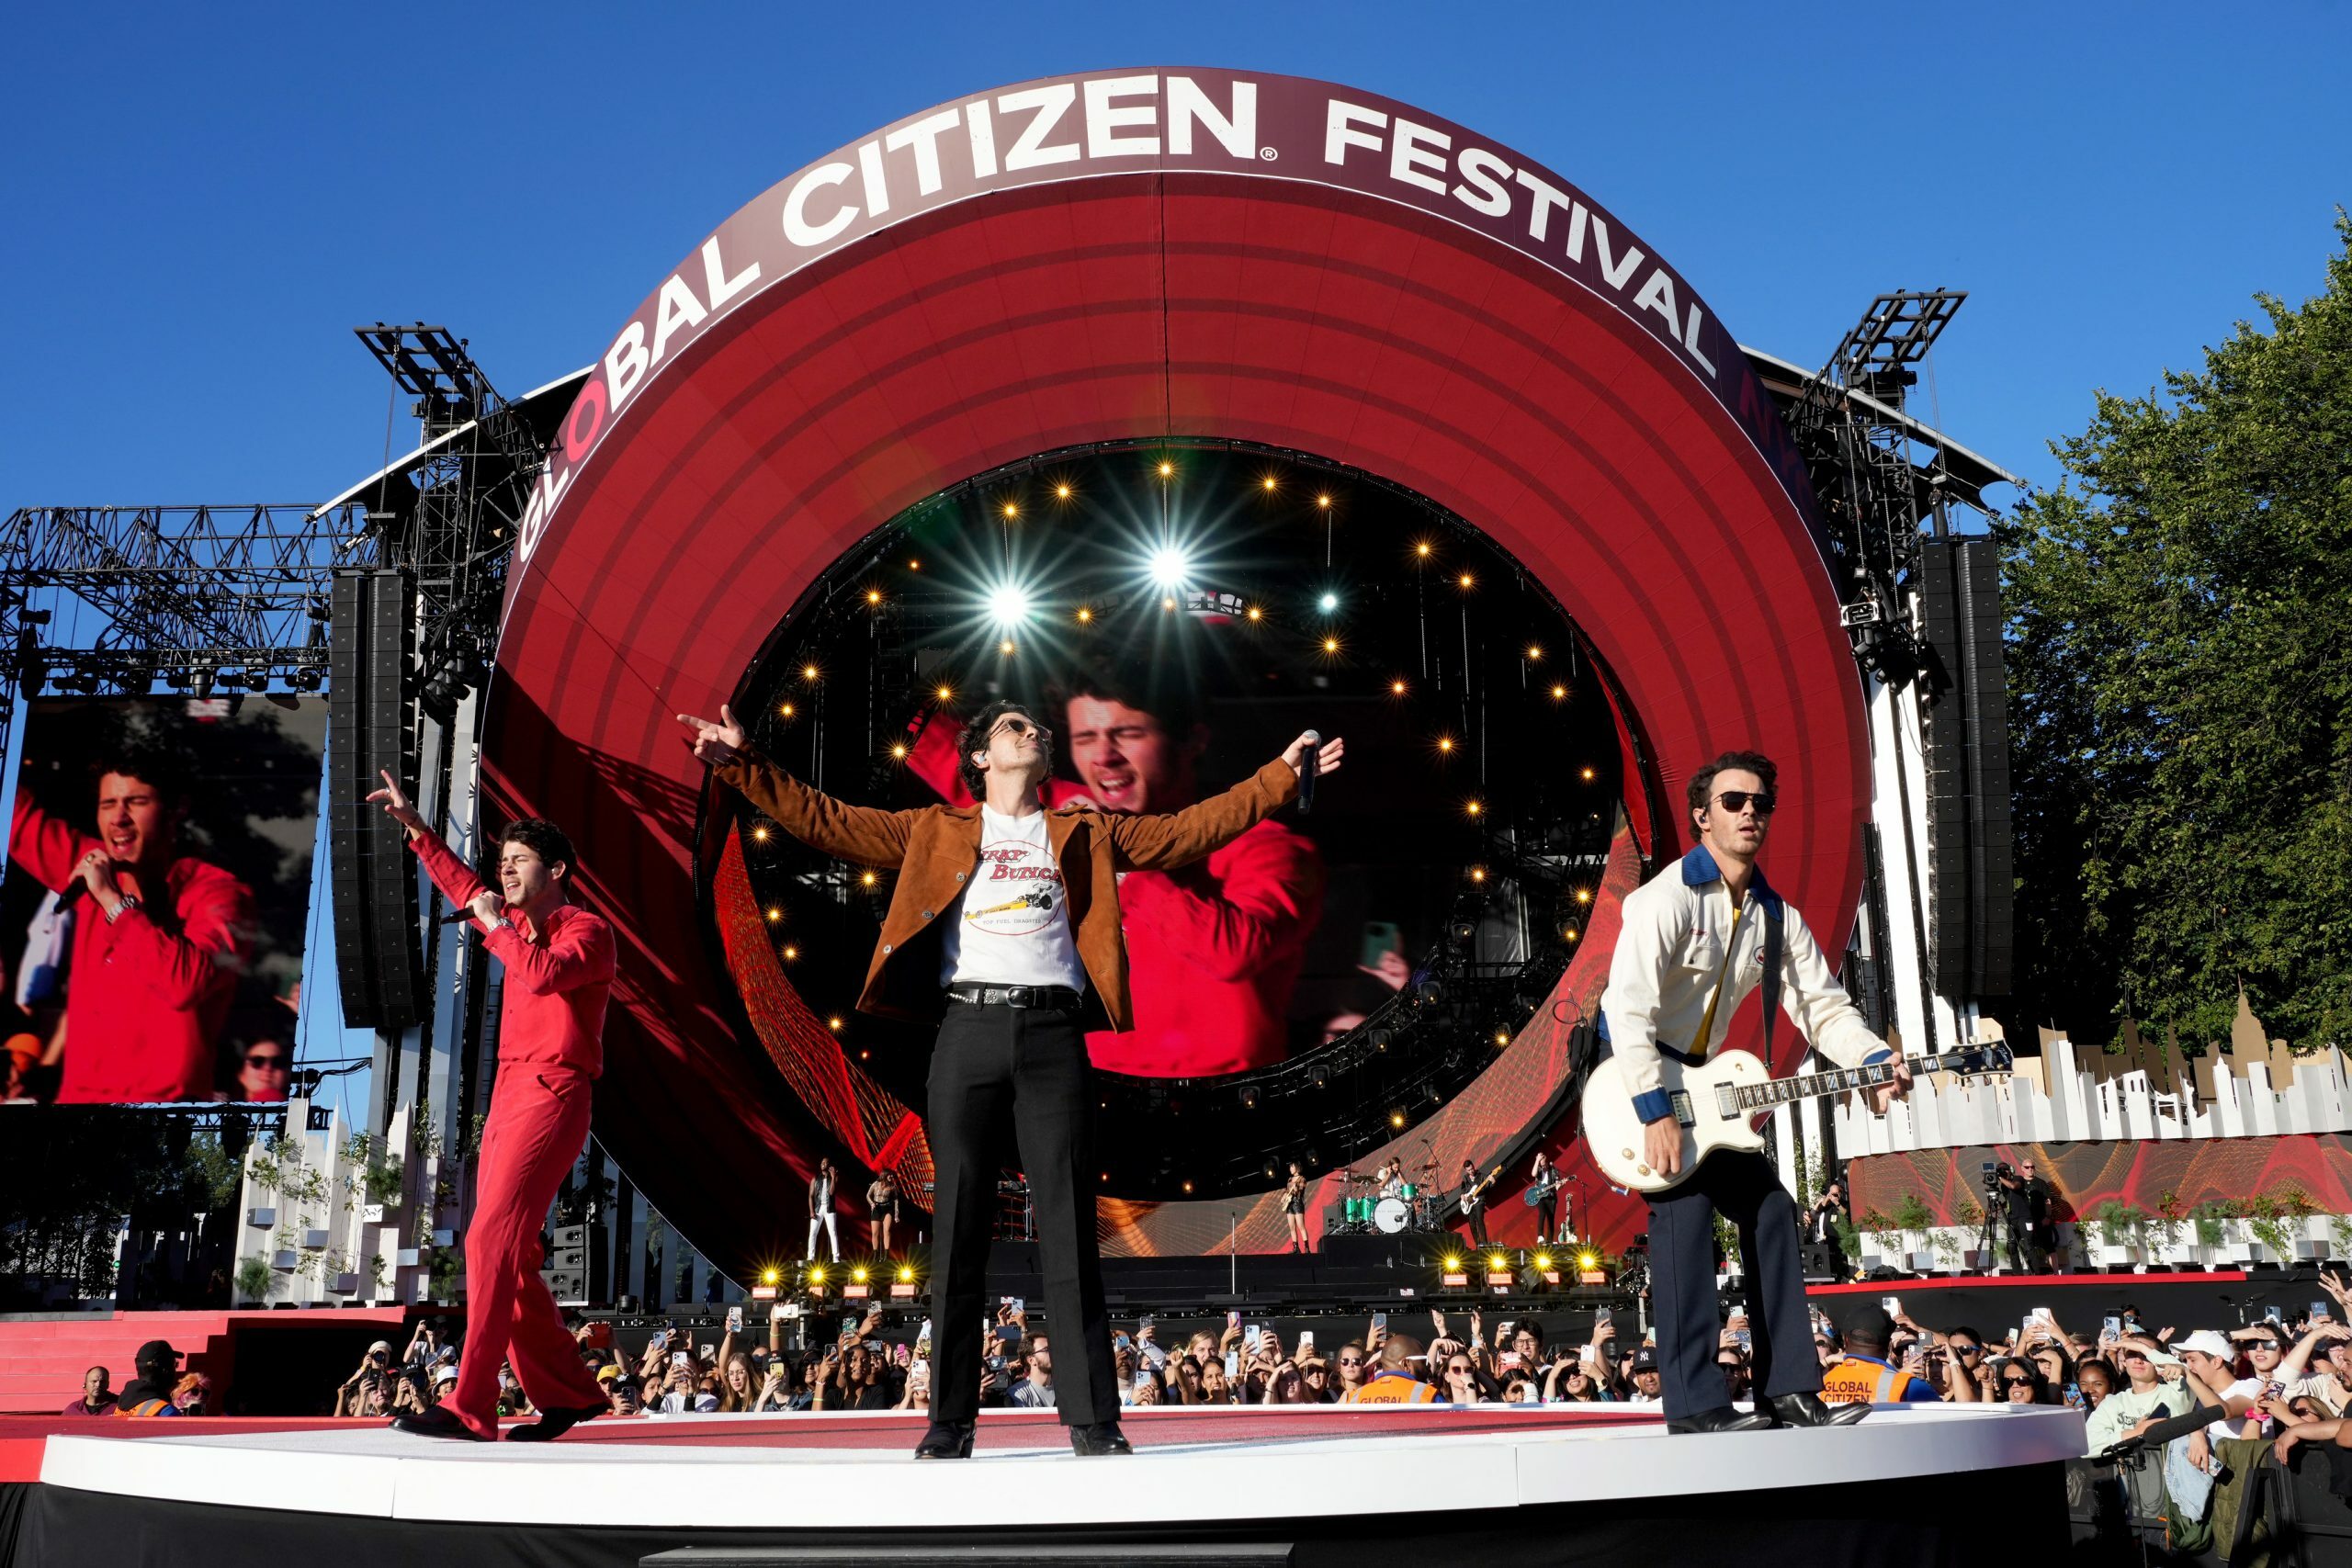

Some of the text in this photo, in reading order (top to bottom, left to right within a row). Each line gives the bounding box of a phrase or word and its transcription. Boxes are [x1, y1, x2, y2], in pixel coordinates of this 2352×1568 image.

[520, 74, 1716, 562] GLOBAL CITIZEN FESTIVAL
[1825, 1382, 1872, 1393] GLOBAL
